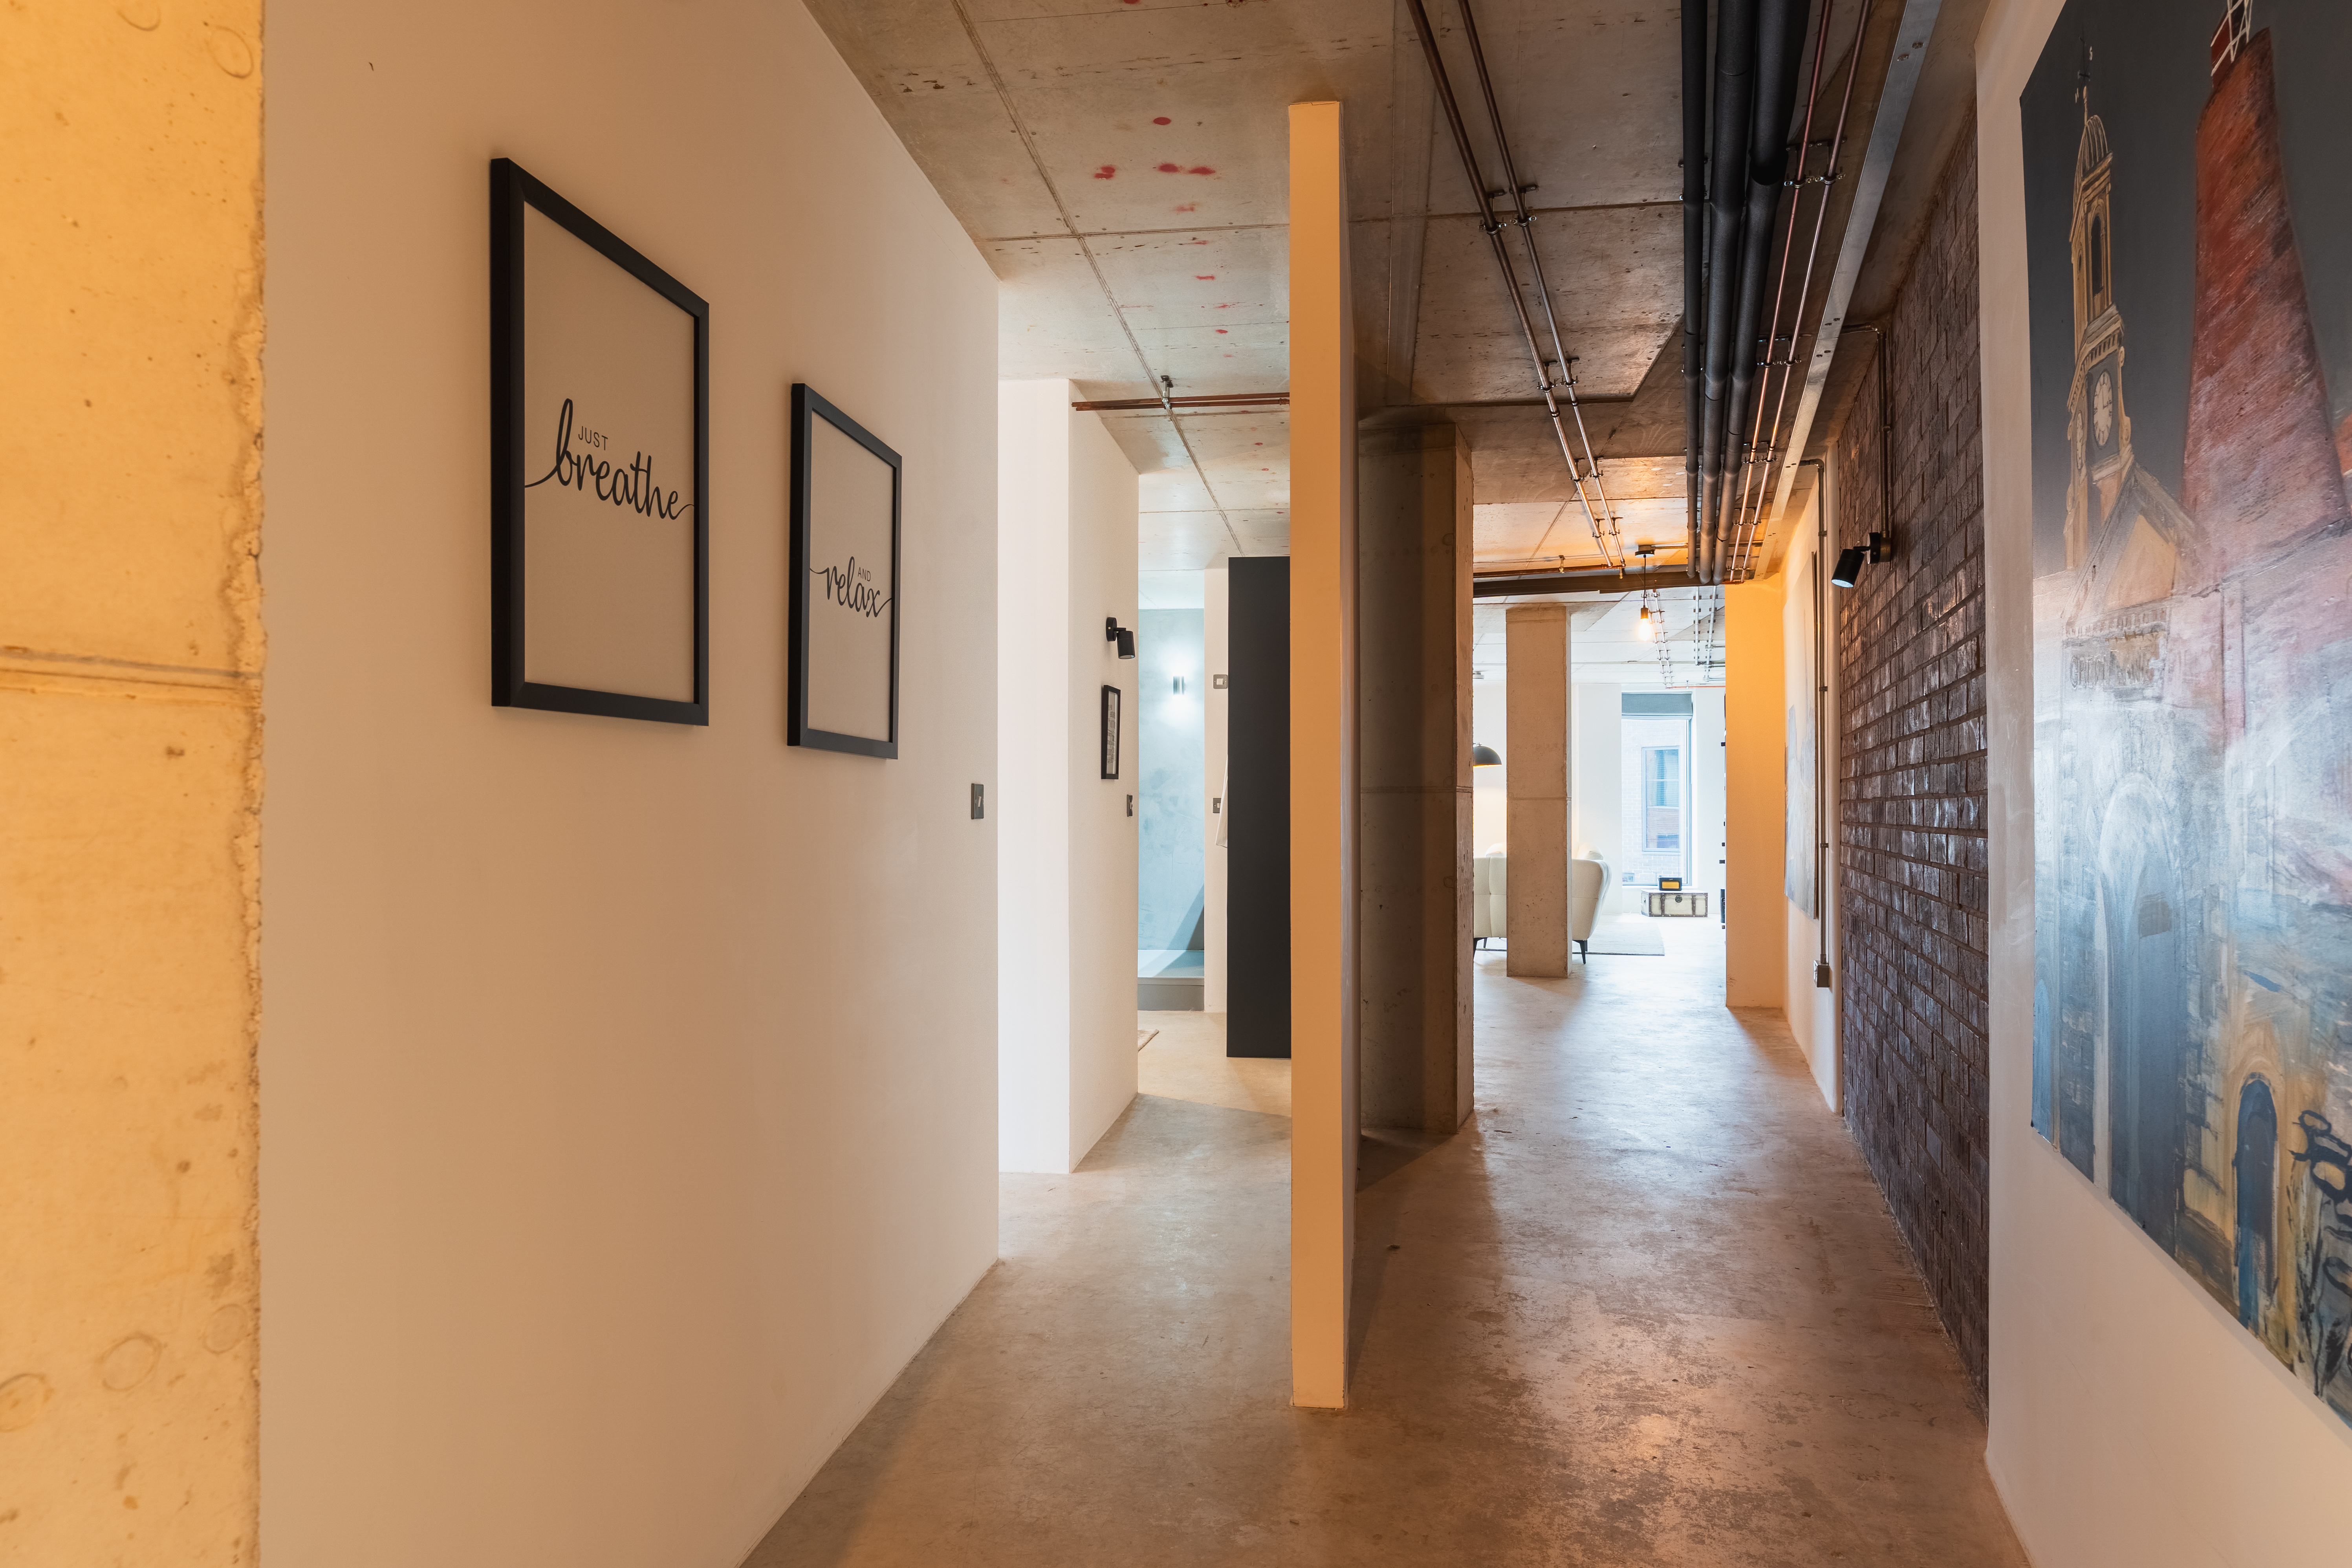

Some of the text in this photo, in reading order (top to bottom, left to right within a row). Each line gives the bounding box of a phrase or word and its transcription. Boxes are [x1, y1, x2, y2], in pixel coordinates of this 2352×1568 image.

[525, 398, 694, 520] breathe
[578, 426, 608, 451] JUST
[810, 556, 892, 617] relax
[857, 567, 871, 582] AND
